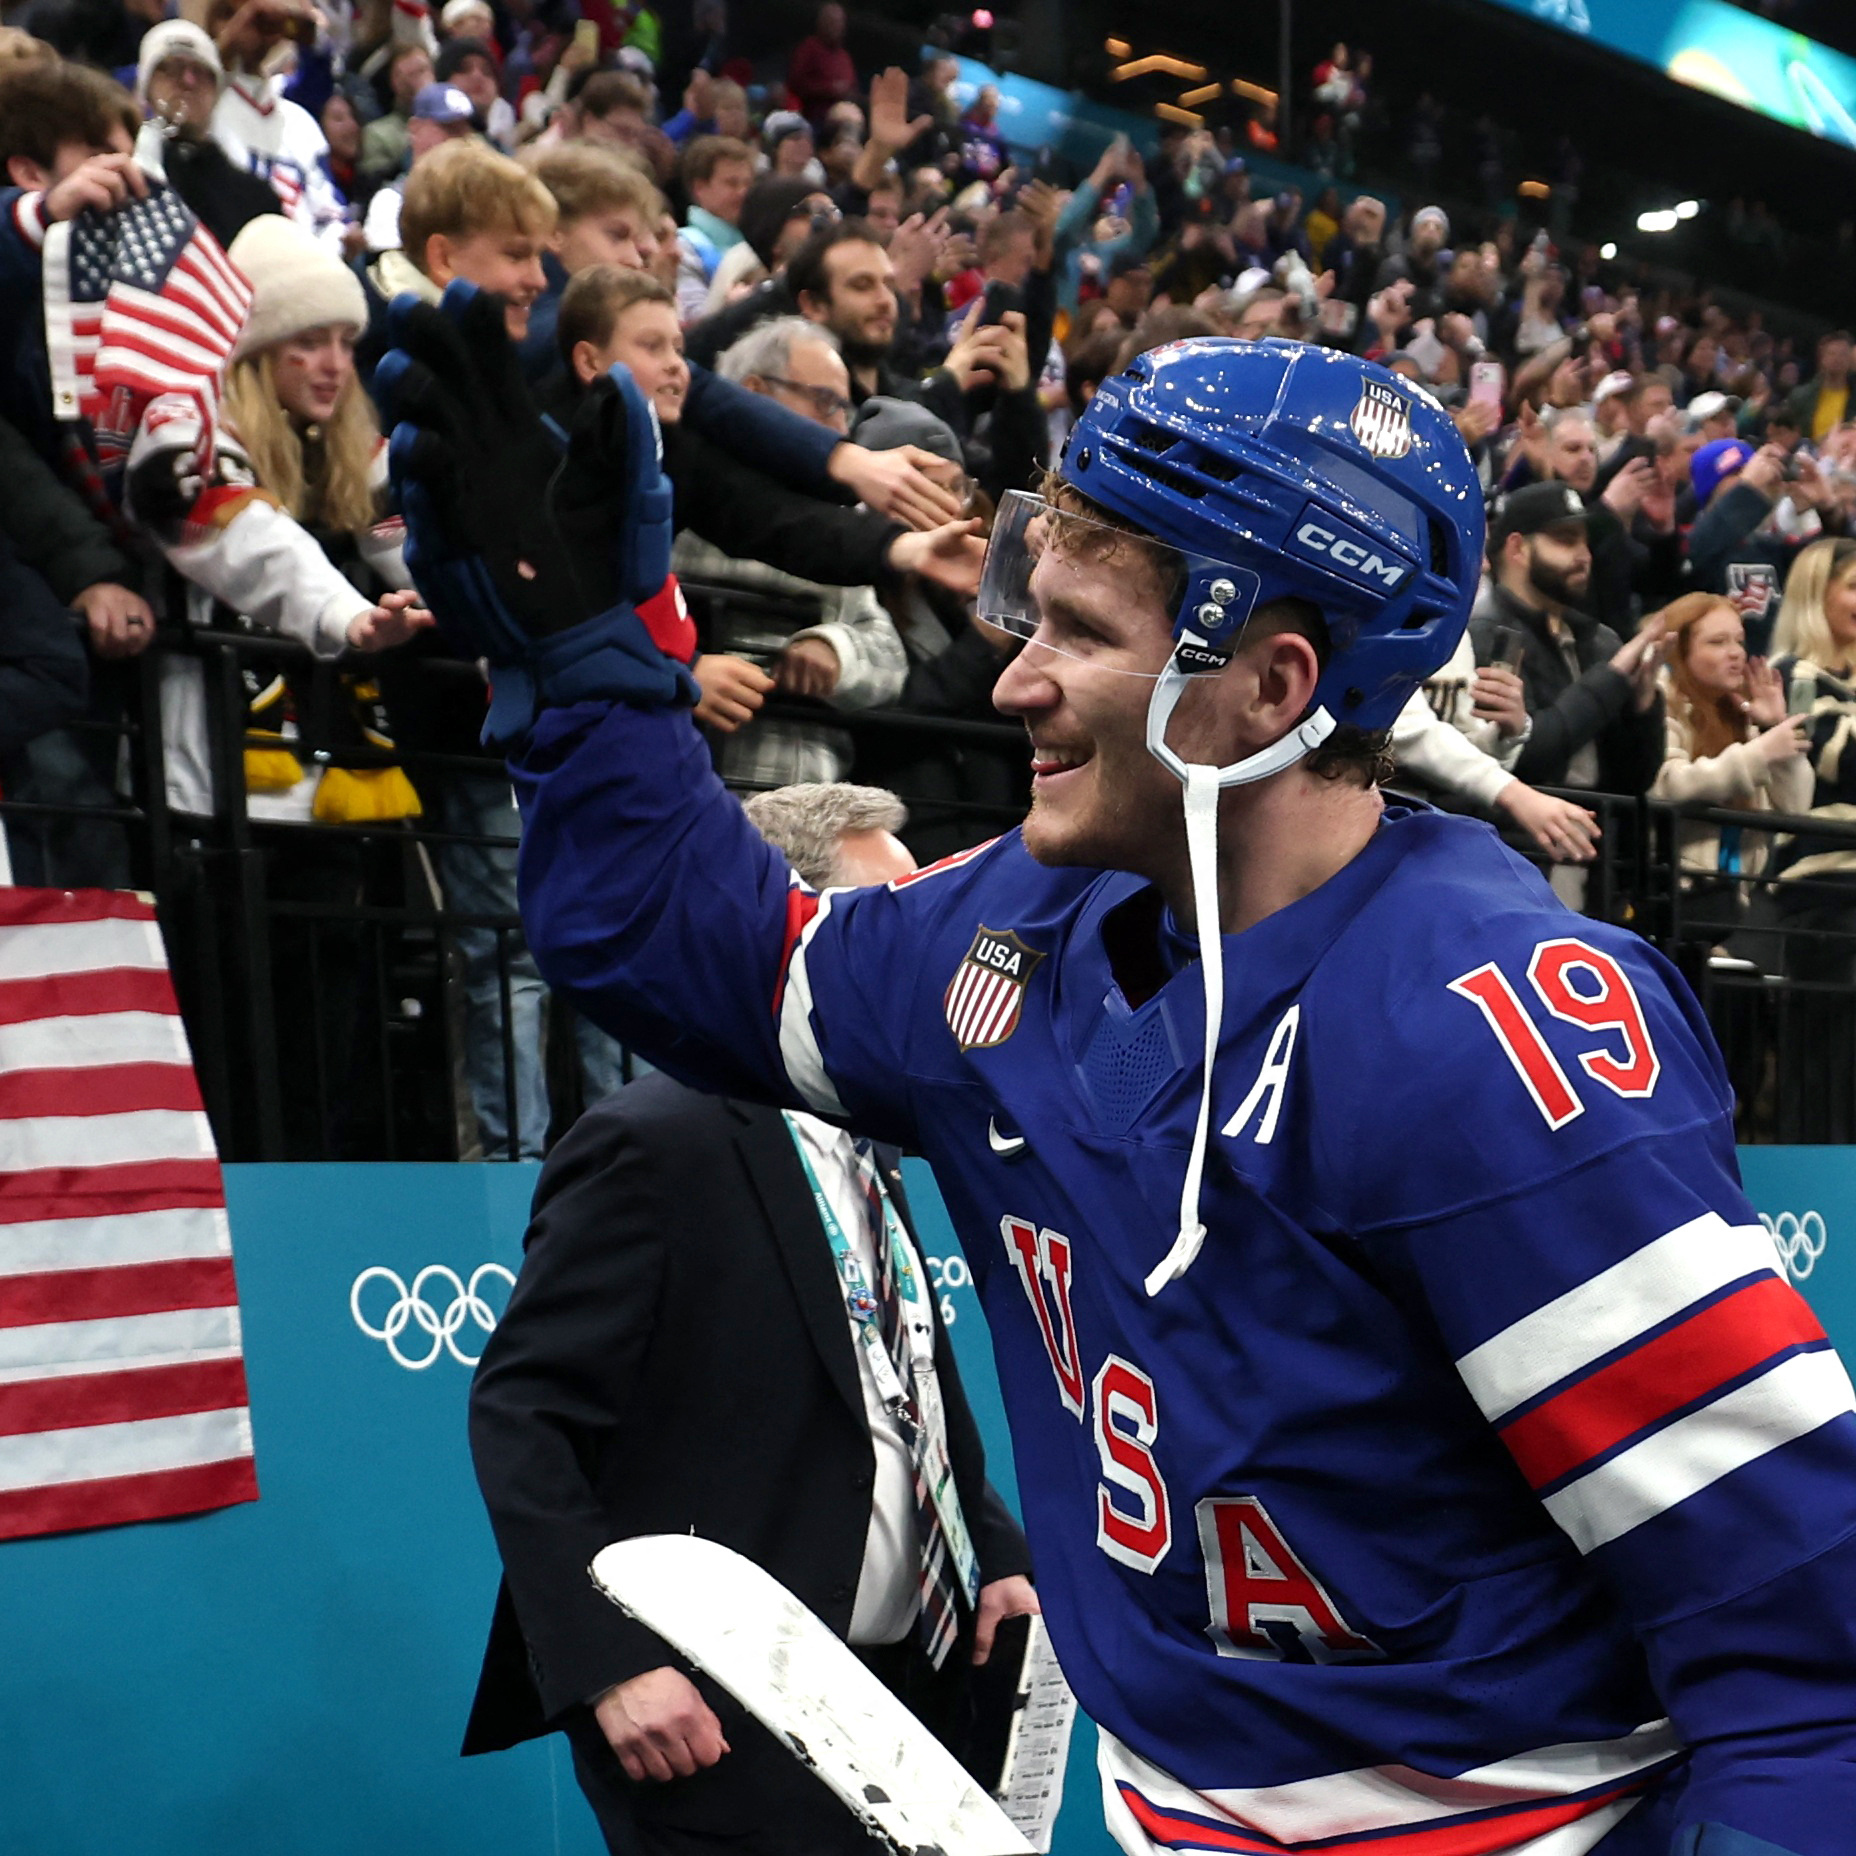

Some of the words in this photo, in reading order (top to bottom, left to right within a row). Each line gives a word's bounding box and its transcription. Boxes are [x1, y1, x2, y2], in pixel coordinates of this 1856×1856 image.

[1370, 384, 1404, 412] USA
[1296, 522, 1406, 587] CCM
[1180, 648, 1227, 667] CCM
[975, 937, 1023, 976] USA
[1447, 937, 1662, 1132] 19
[1220, 1003, 1301, 1146] A
[999, 1213, 1388, 1665] USA
